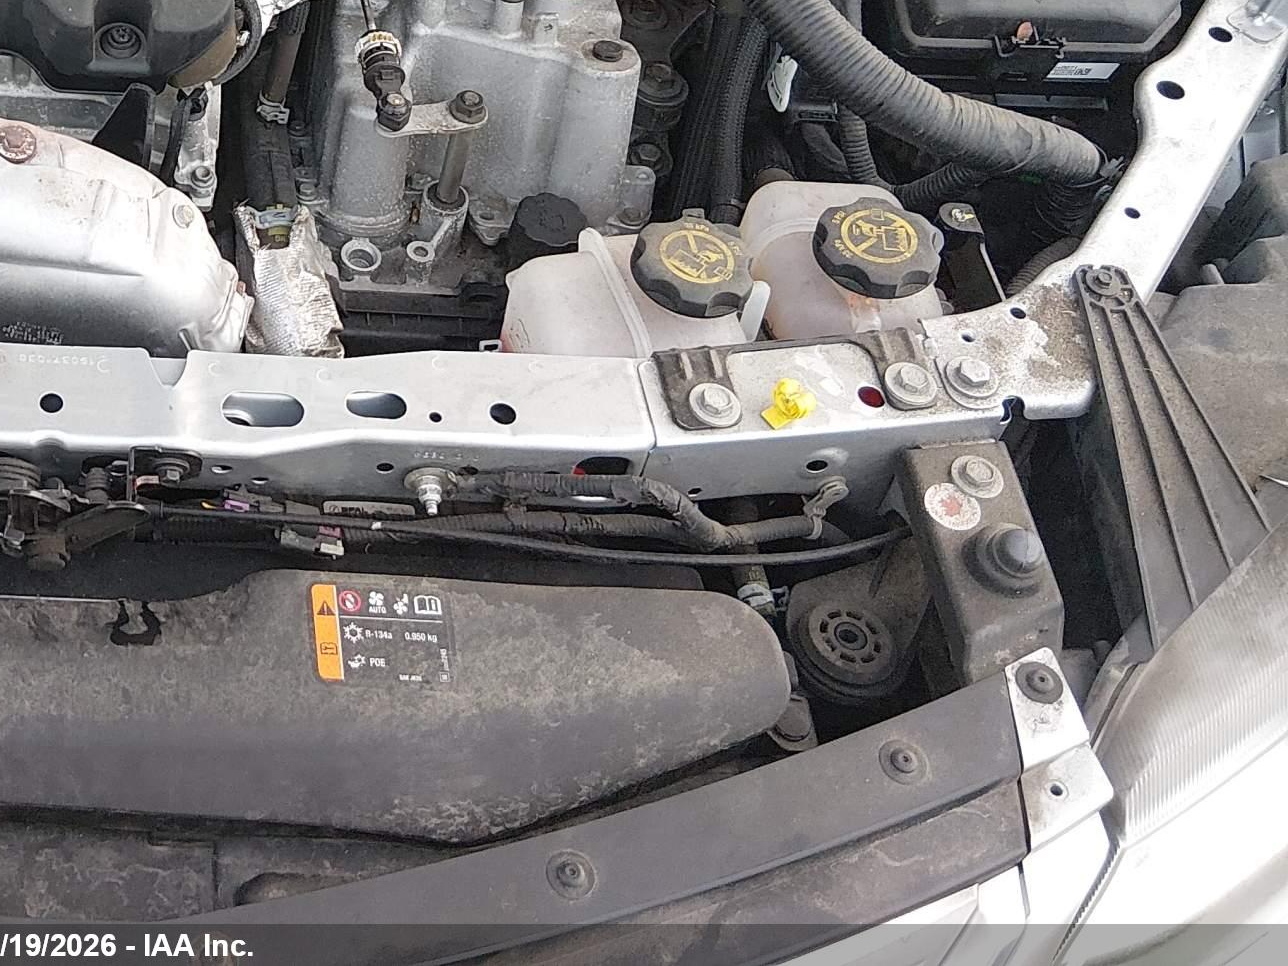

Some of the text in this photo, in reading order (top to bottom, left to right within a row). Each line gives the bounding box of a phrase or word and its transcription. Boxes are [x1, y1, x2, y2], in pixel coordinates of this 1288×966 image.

[368, 606, 387, 614] AUTO
[365, 630, 438, 643] R-134a 0.950 kg
[369, 657, 386, 667] POE
